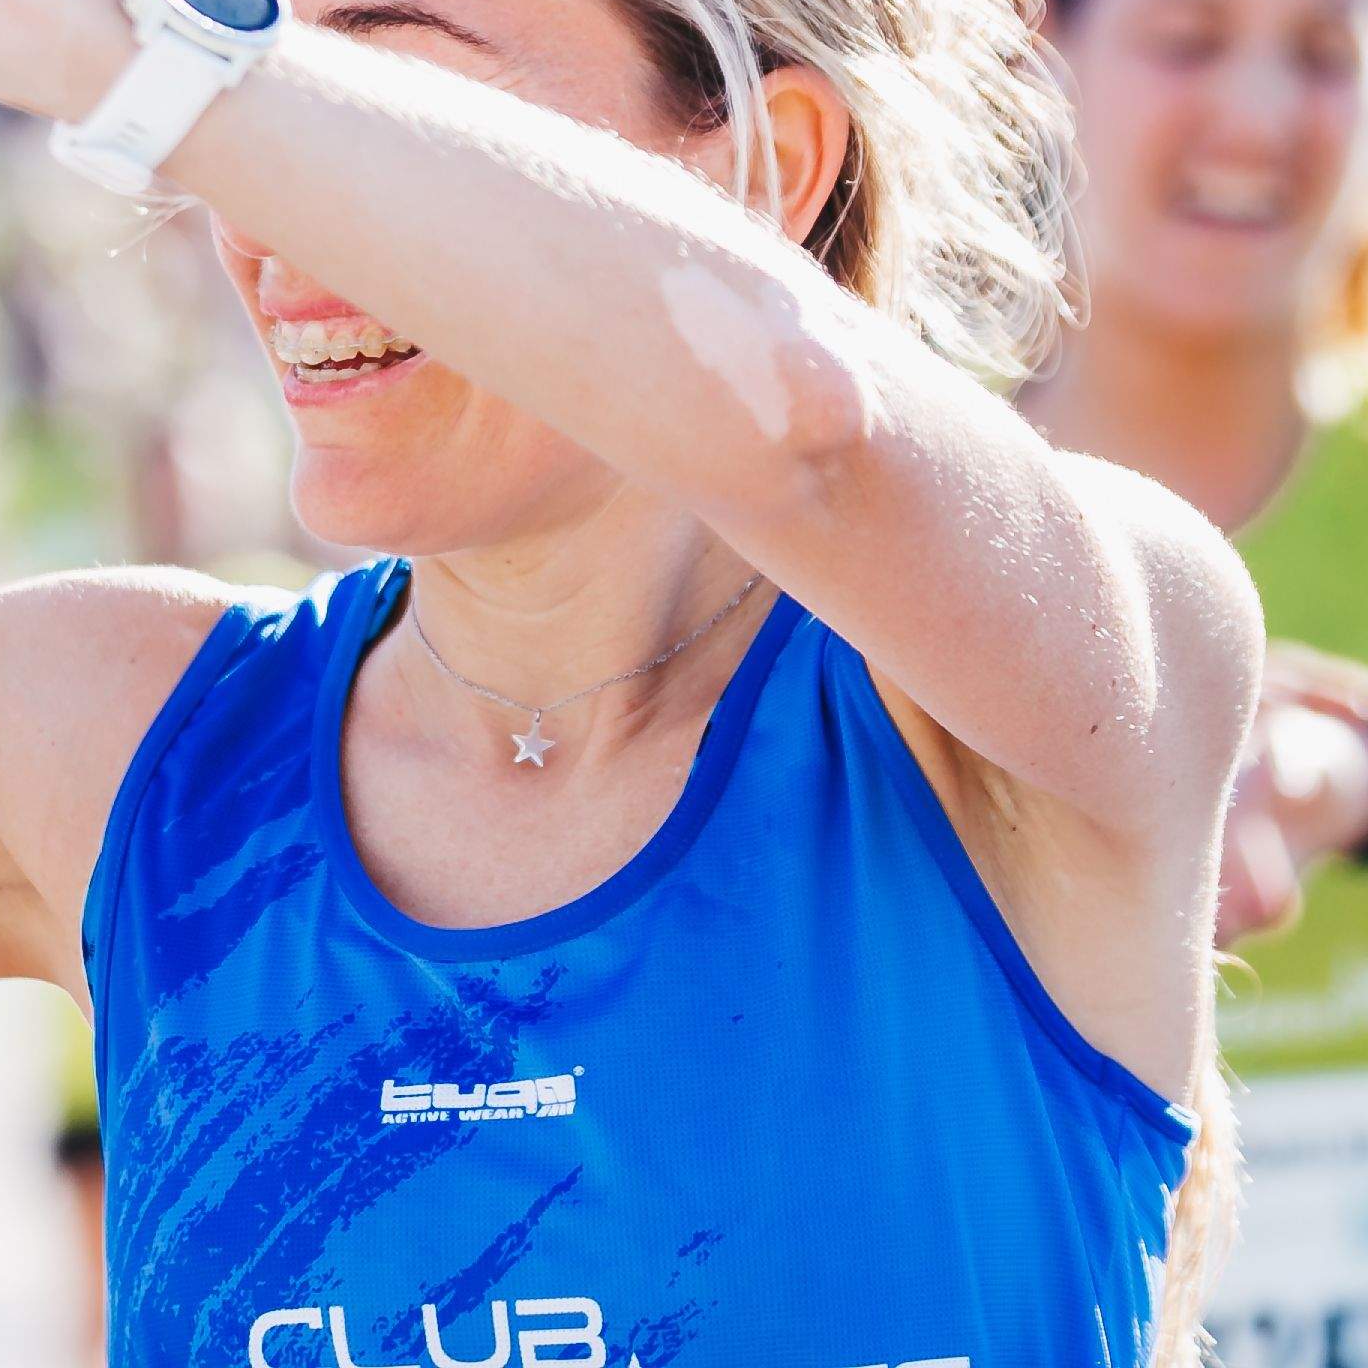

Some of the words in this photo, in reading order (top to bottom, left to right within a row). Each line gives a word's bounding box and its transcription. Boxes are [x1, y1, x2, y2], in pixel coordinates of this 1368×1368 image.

[381, 1110, 450, 1124] ACTIVE
[459, 1107, 524, 1121] WEAR
[248, 1297, 607, 1368] CLUB
